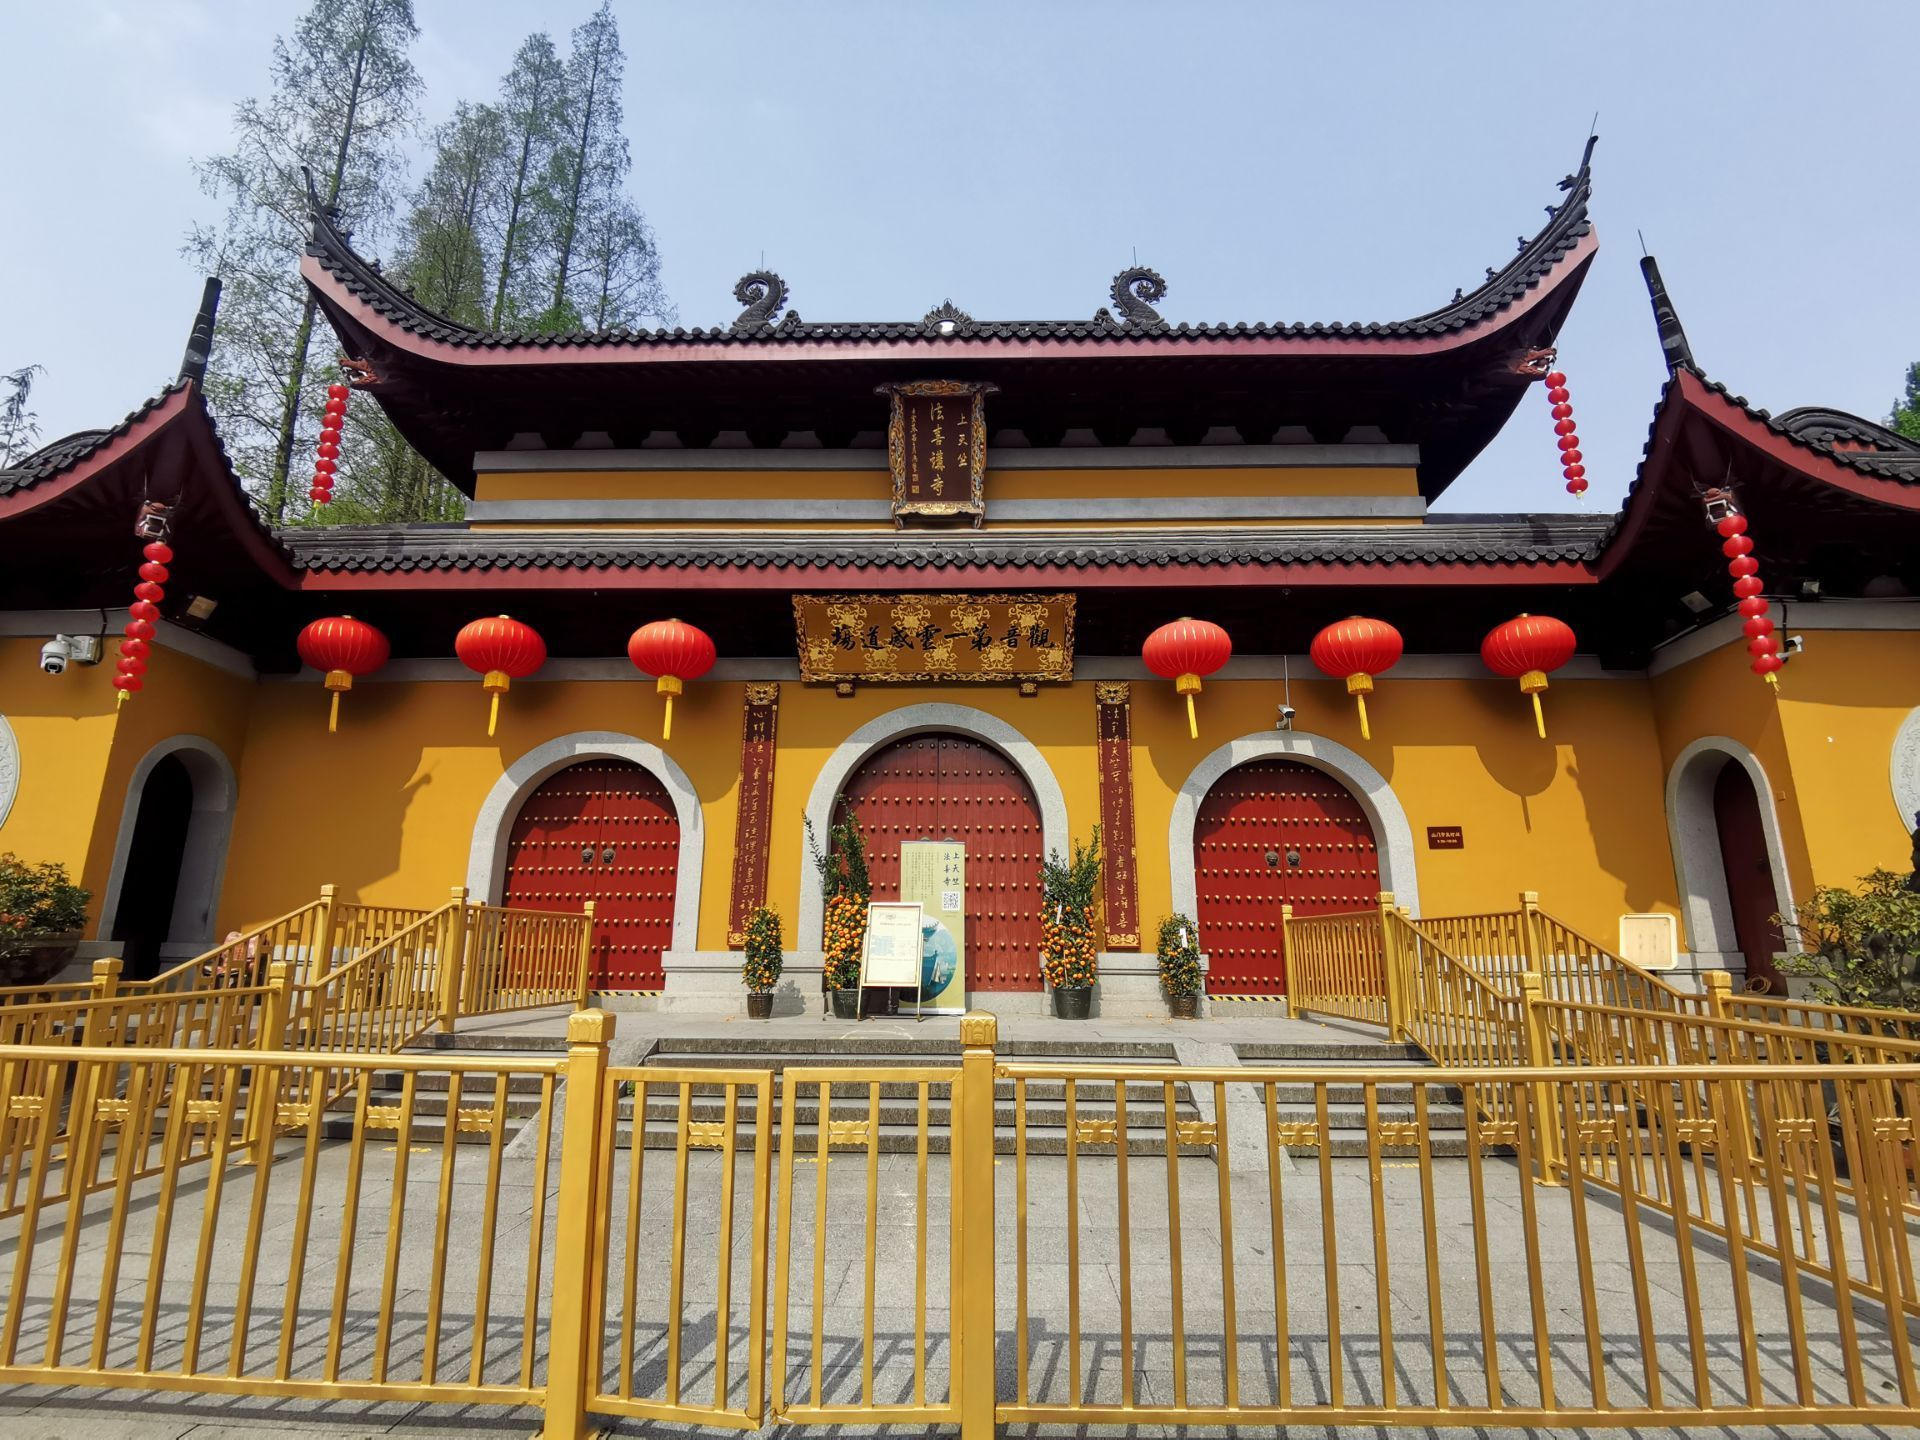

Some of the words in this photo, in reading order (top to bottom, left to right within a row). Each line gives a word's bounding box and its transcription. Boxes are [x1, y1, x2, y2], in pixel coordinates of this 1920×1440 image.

[929, 402, 946, 497] 法喜講寺
[957, 412, 969, 468] 上天竺
[952, 852, 960, 886] 上天竺
